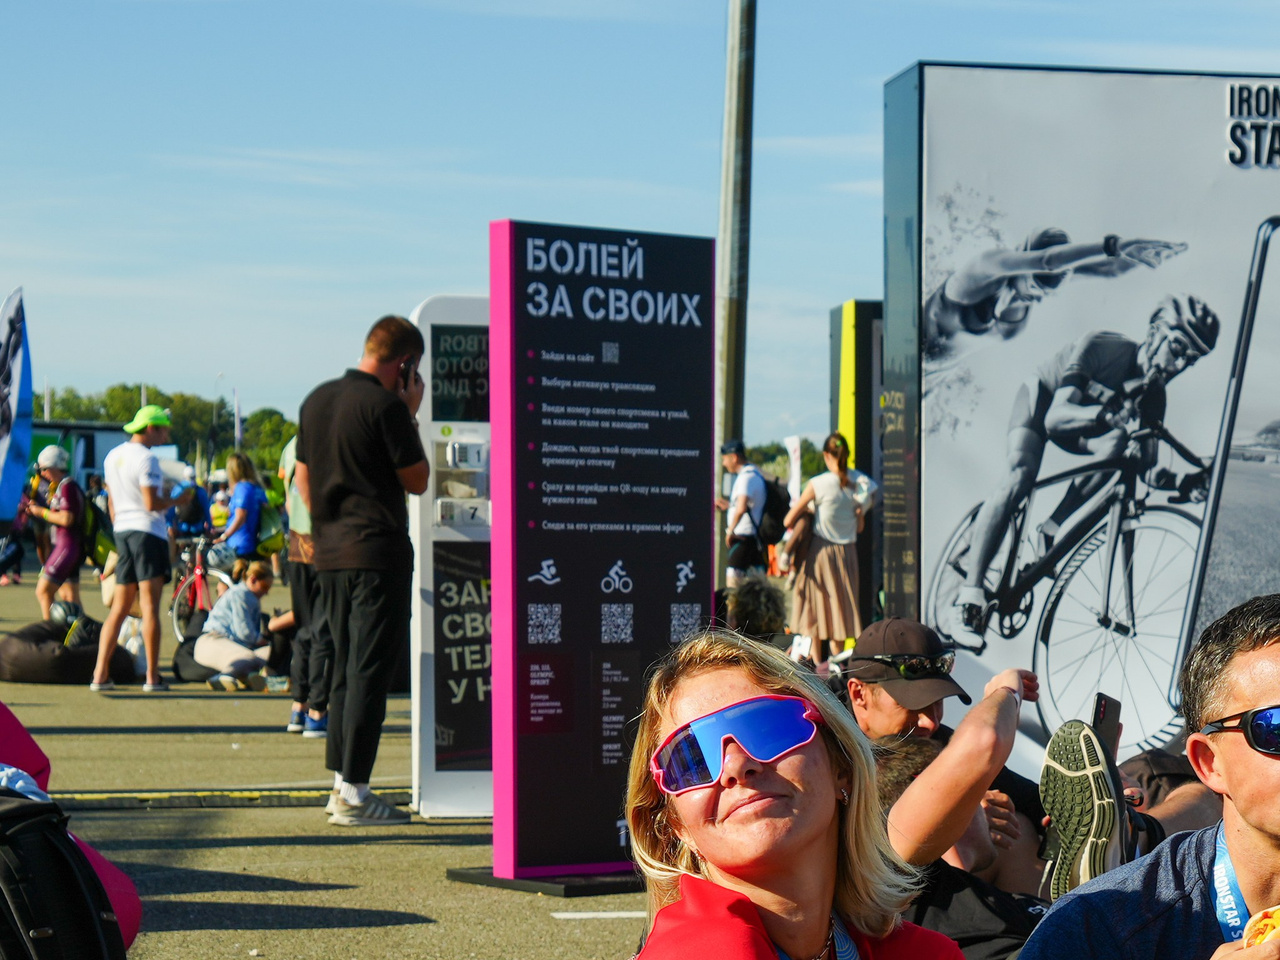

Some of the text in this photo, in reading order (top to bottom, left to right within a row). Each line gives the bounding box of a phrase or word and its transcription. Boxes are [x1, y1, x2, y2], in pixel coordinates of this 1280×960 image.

[526, 237, 644, 280] БОЛЕЙ
[526, 281, 702, 328] ЗА СВОИХ
[467, 506, 478, 519] 7
[1213, 863, 1241, 928] IRONSTAR
